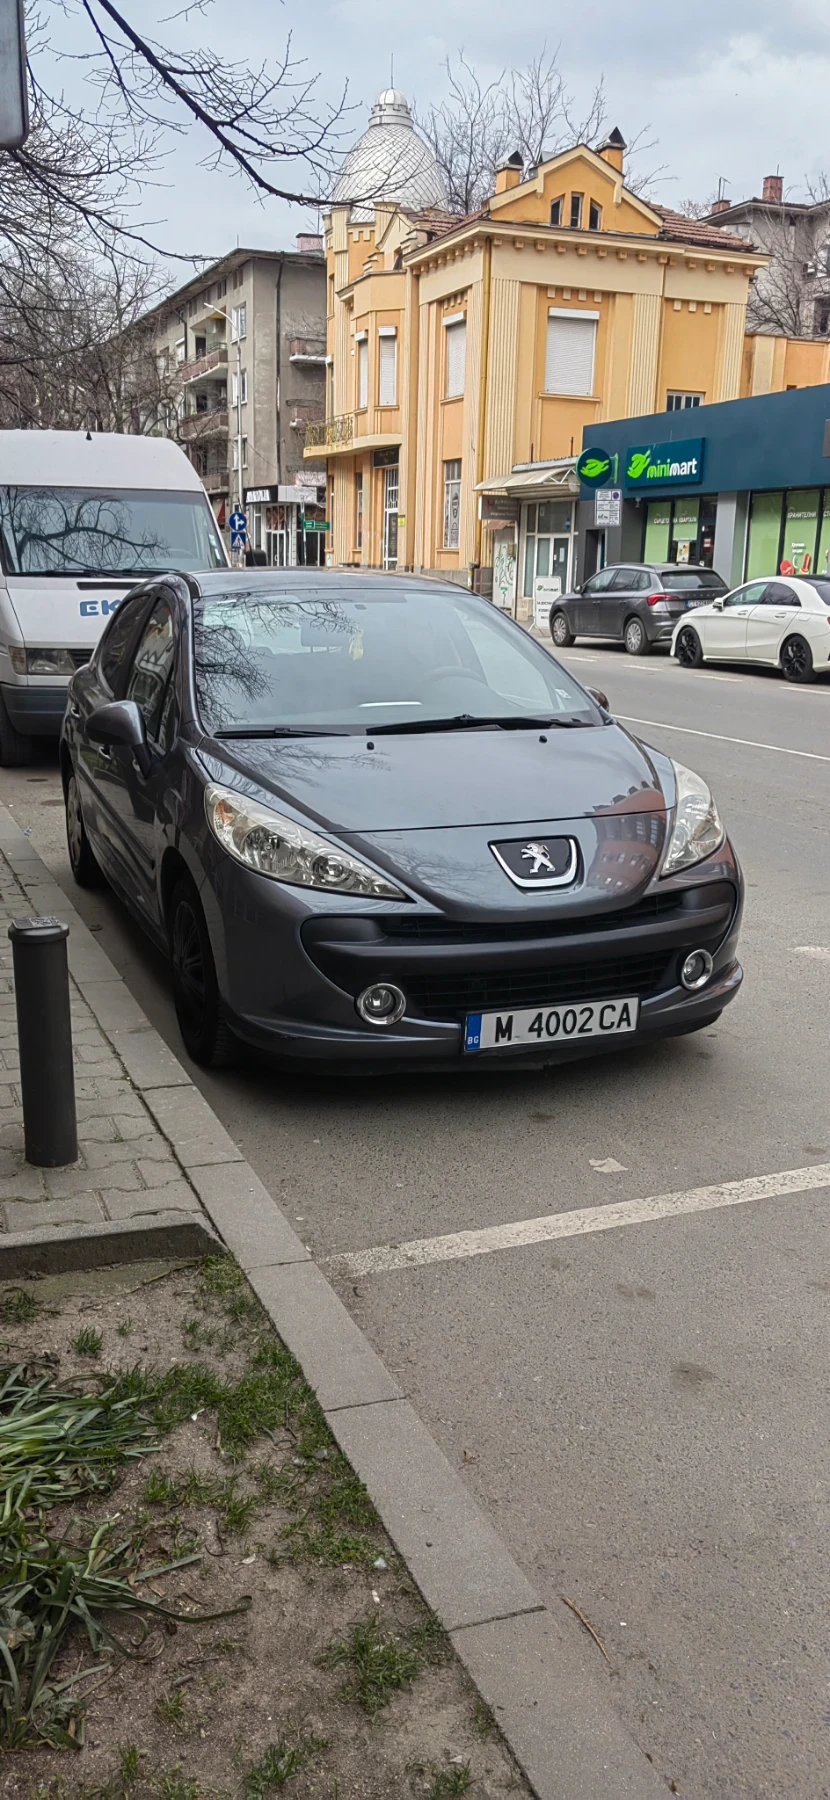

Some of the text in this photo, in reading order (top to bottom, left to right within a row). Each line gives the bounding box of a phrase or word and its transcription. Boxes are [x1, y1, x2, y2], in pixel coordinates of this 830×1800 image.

[646, 457, 697, 478] minimart
[494, 1014, 514, 1043] M
[528, 1007, 595, 1039] 4002
[467, 1035, 479, 1045] BG
